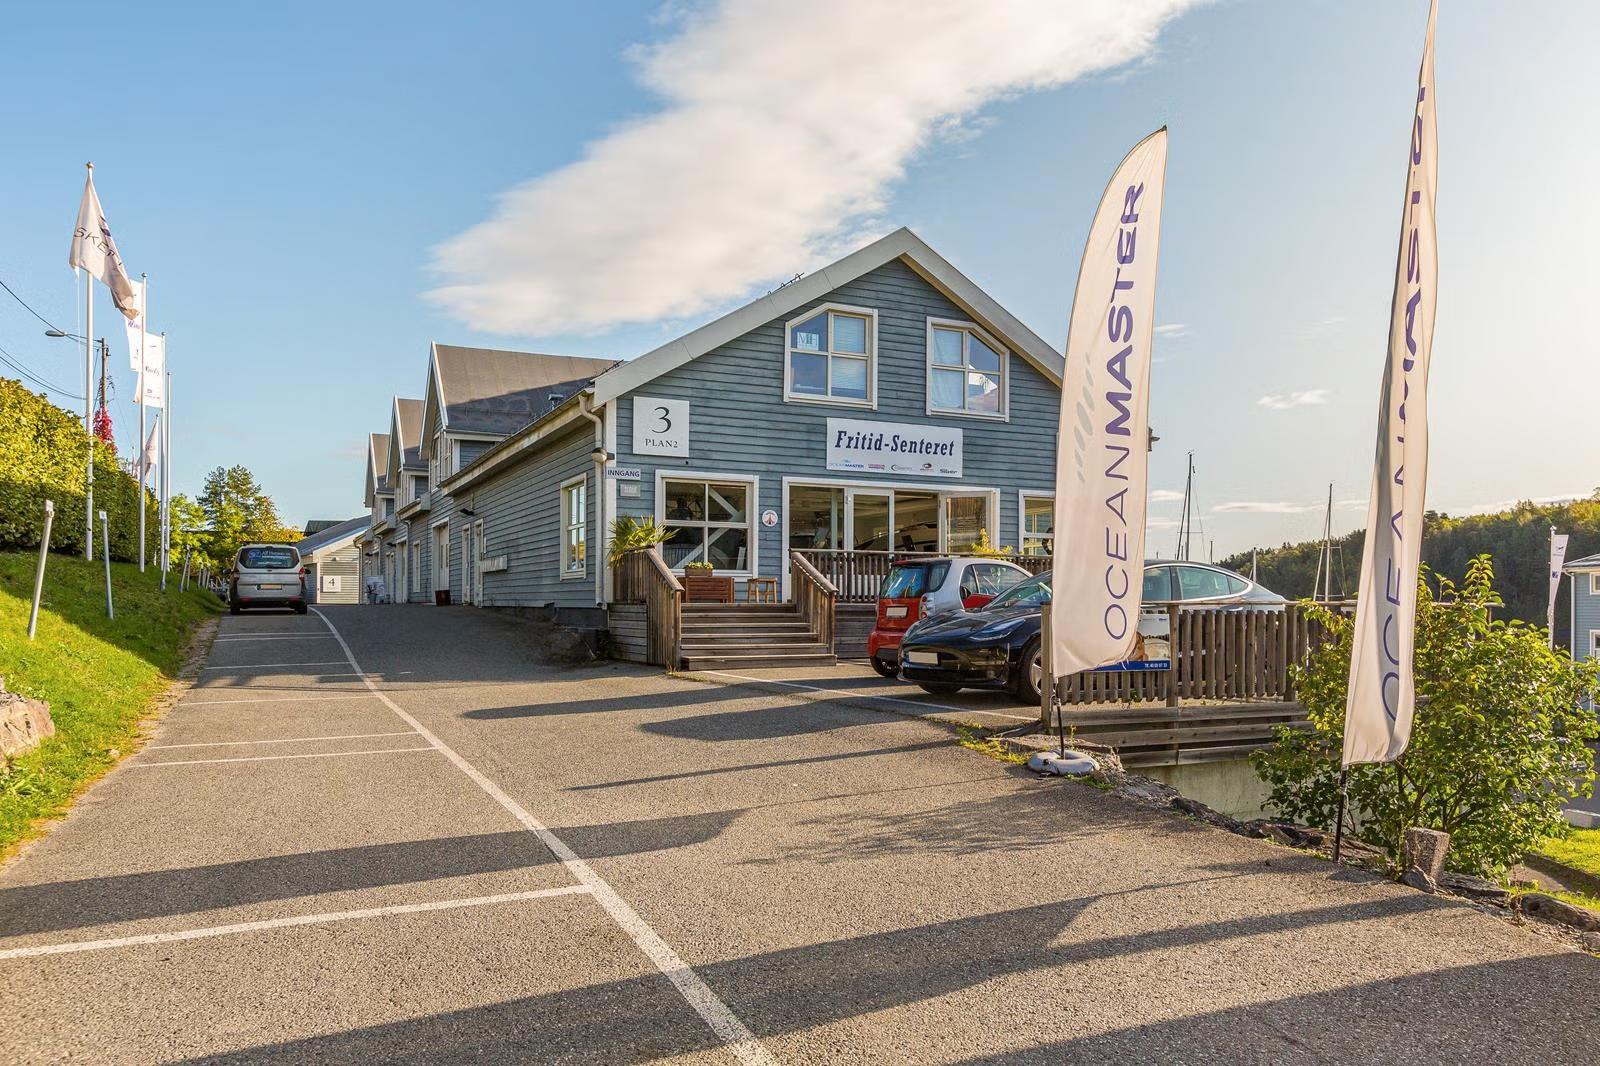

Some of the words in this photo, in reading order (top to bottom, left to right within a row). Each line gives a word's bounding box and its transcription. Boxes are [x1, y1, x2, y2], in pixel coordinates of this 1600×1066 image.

[652, 406, 672, 434] 3
[1103, 182, 1144, 640] OCEANMASTER
[835, 430, 954, 456] Fritid-Senteret
[607, 469, 640, 477] INNGANG
[328, 577, 335, 587] 4
